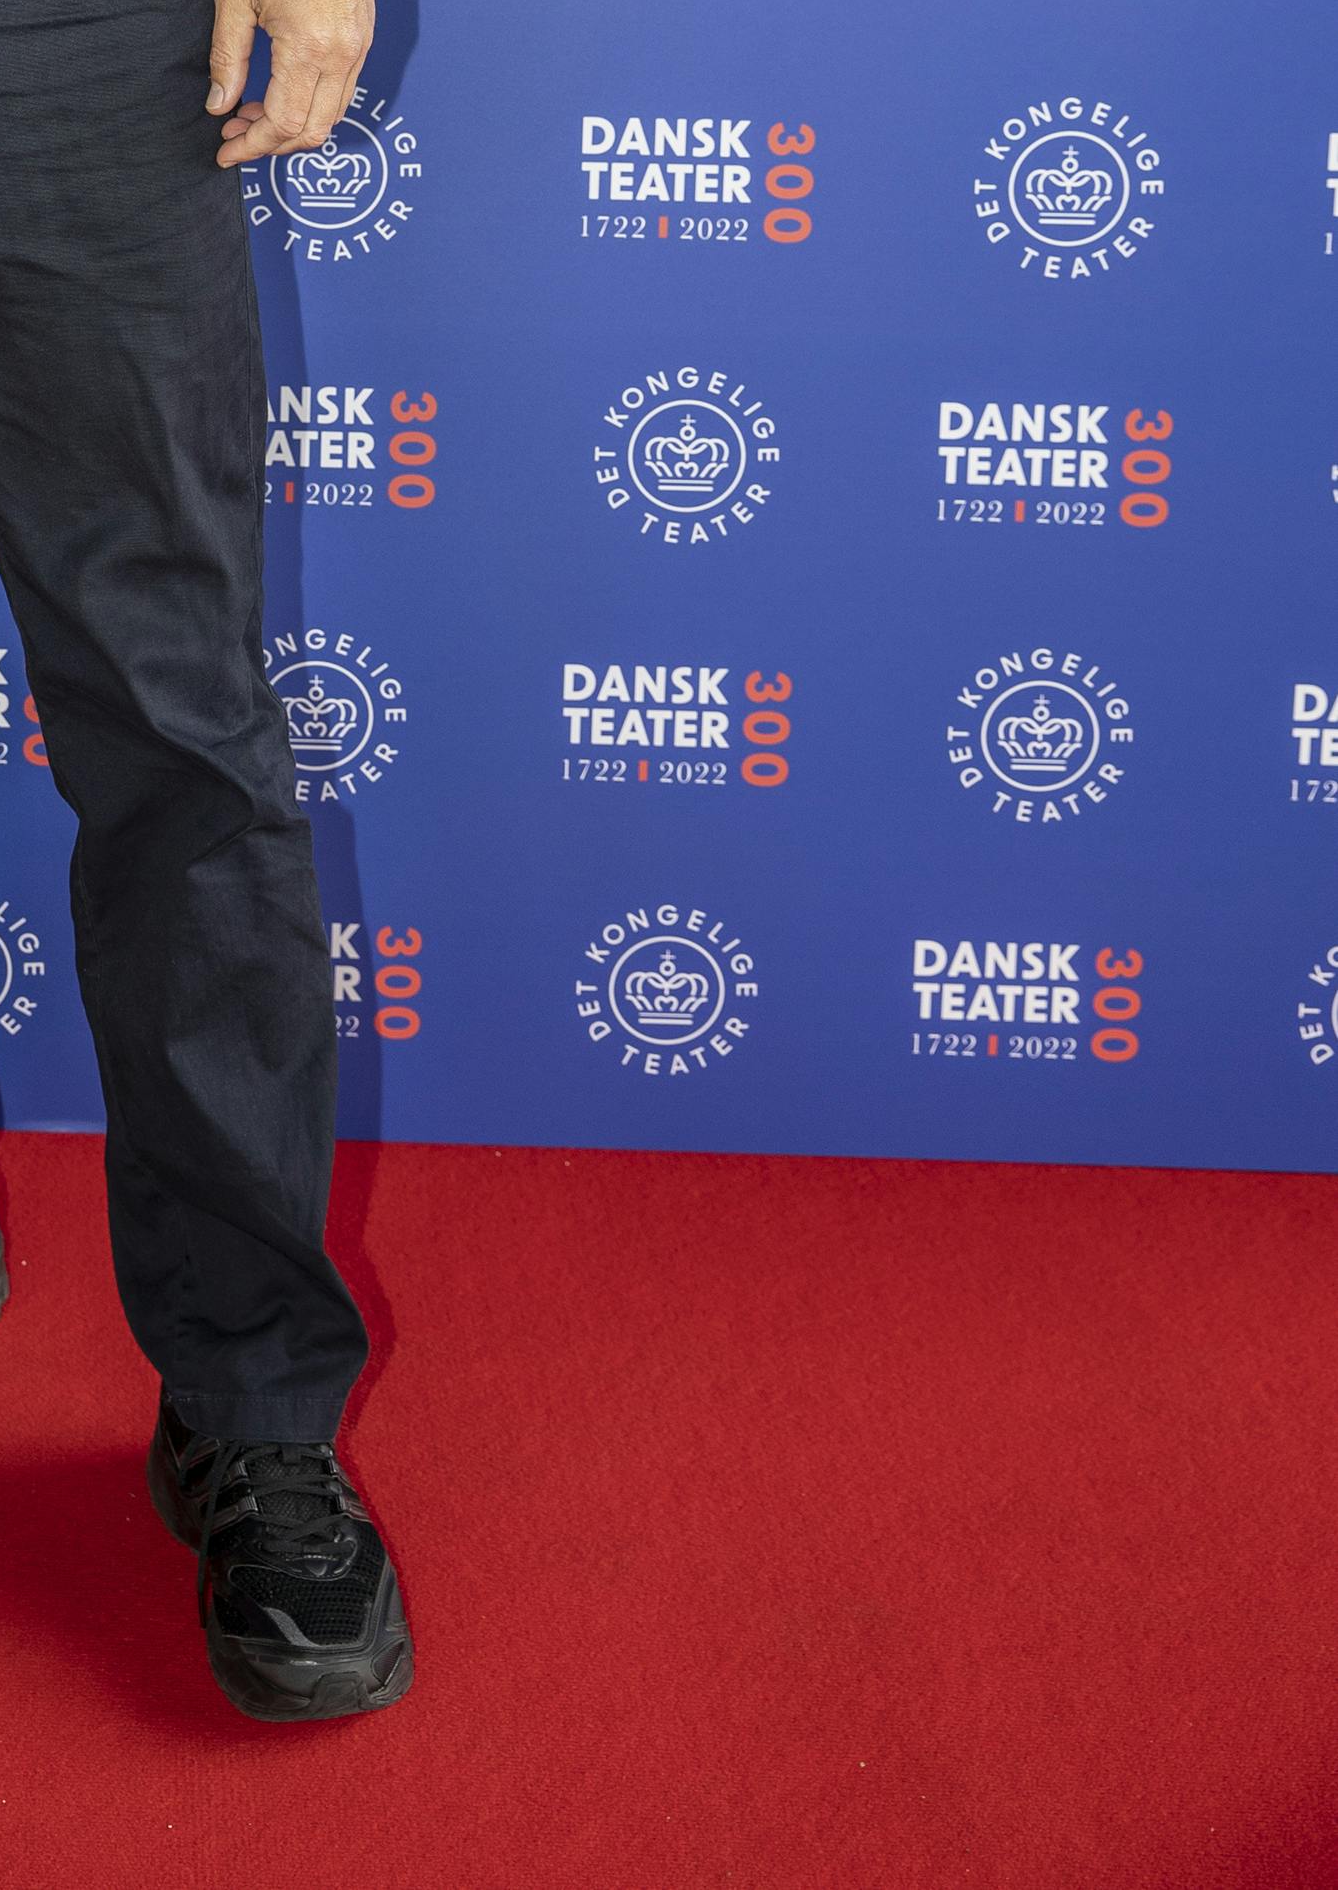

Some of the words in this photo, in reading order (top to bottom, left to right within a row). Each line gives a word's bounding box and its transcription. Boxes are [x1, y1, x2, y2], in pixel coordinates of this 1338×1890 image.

[581, 115, 752, 159] DANSK
[580, 161, 752, 204] TEATER
[762, 121, 817, 245] 300
[283, 199, 414, 262] TEATER
[580, 214, 647, 239] 1722
[679, 217, 749, 242] 2022
[603, 366, 781, 462] KONGELIGE
[264, 429, 376, 470] ATER
[386, 389, 438, 510] 300
[593, 445, 631, 510] DET
[305, 482, 374, 507] 2022
[640, 483, 772, 545] TEATER
[562, 663, 730, 706] DANSK
[956, 647, 1134, 743] KONGELIGE
[562, 706, 730, 749] TEATER
[740, 669, 794, 788] 300
[946, 725, 984, 789] DET
[562, 758, 628, 783] 1722
[659, 760, 728, 785] 2022
[992, 763, 1125, 824] TEATER
[373, 925, 423, 1041] 300
[912, 939, 1081, 982] DANSK
[912, 981, 1081, 1025] TEATER
[1089, 946, 1144, 1064] 300
[1297, 1002, 1335, 1065] DET
[912, 1032, 978, 1057] 1722
[1008, 1035, 1078, 1060] 2022
